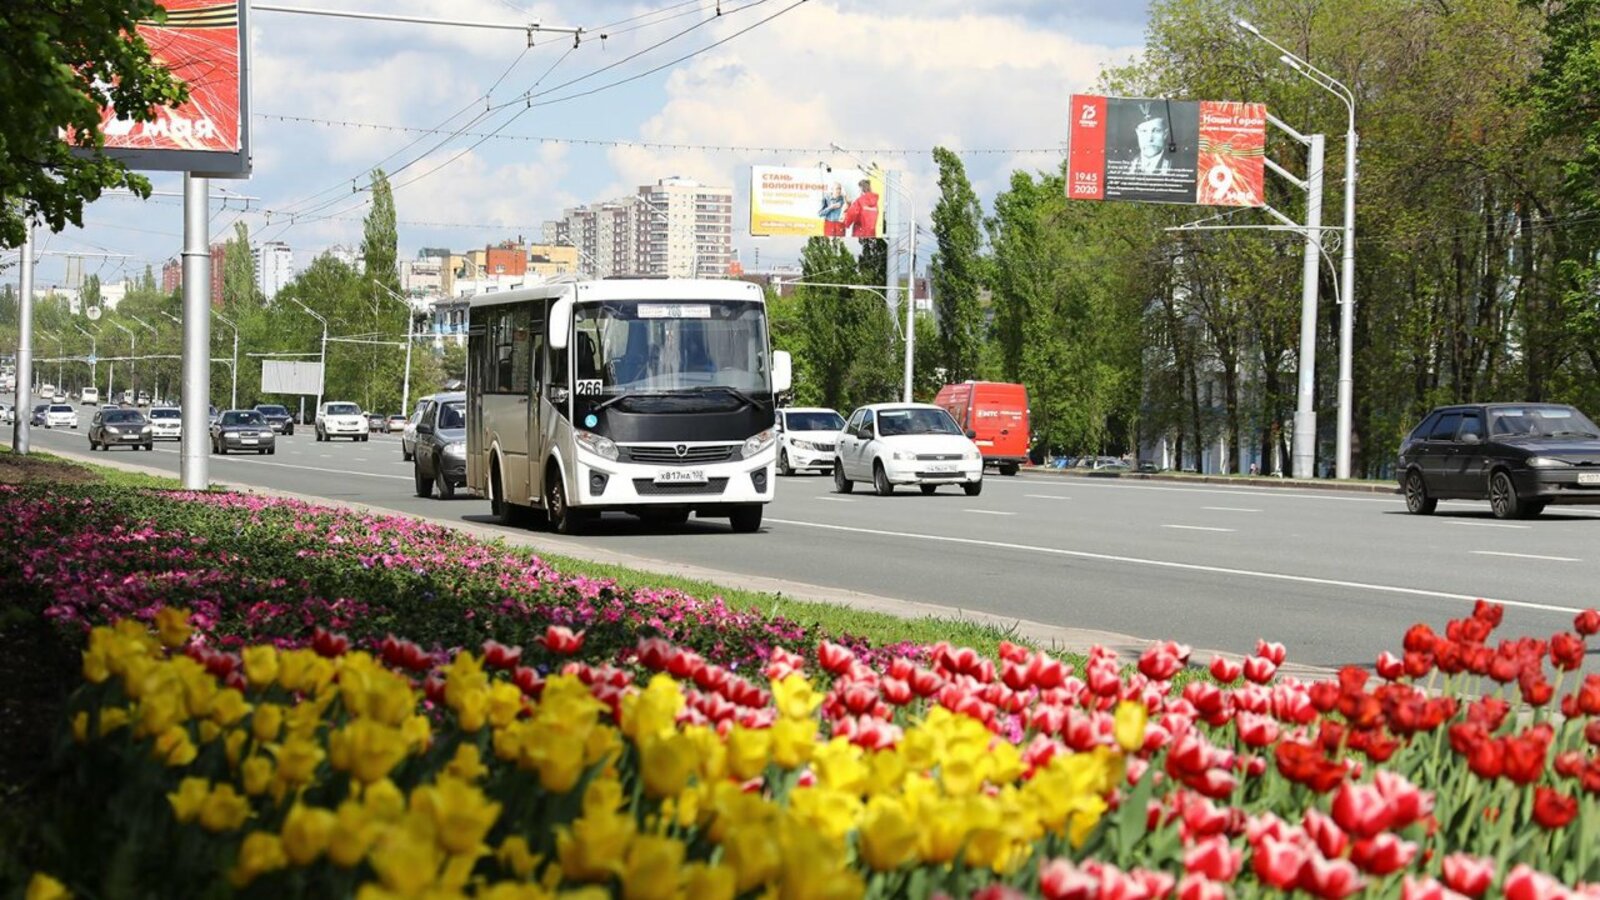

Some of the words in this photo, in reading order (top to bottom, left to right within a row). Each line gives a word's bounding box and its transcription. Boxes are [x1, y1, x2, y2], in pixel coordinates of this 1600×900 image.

[1203, 114, 1231, 123] Наши
[1233, 116, 1264, 126] Герои
[143, 118, 215, 138] мая
[762, 173, 793, 181] СТАНЬ
[1075, 172, 1097, 182] 1945
[1208, 164, 1233, 200] 9
[762, 182, 828, 191] ВОЛОНТЕРОМ!
[1074, 185, 1097, 194] 2020
[1226, 191, 1255, 201] мая
[577, 381, 601, 395] 266
